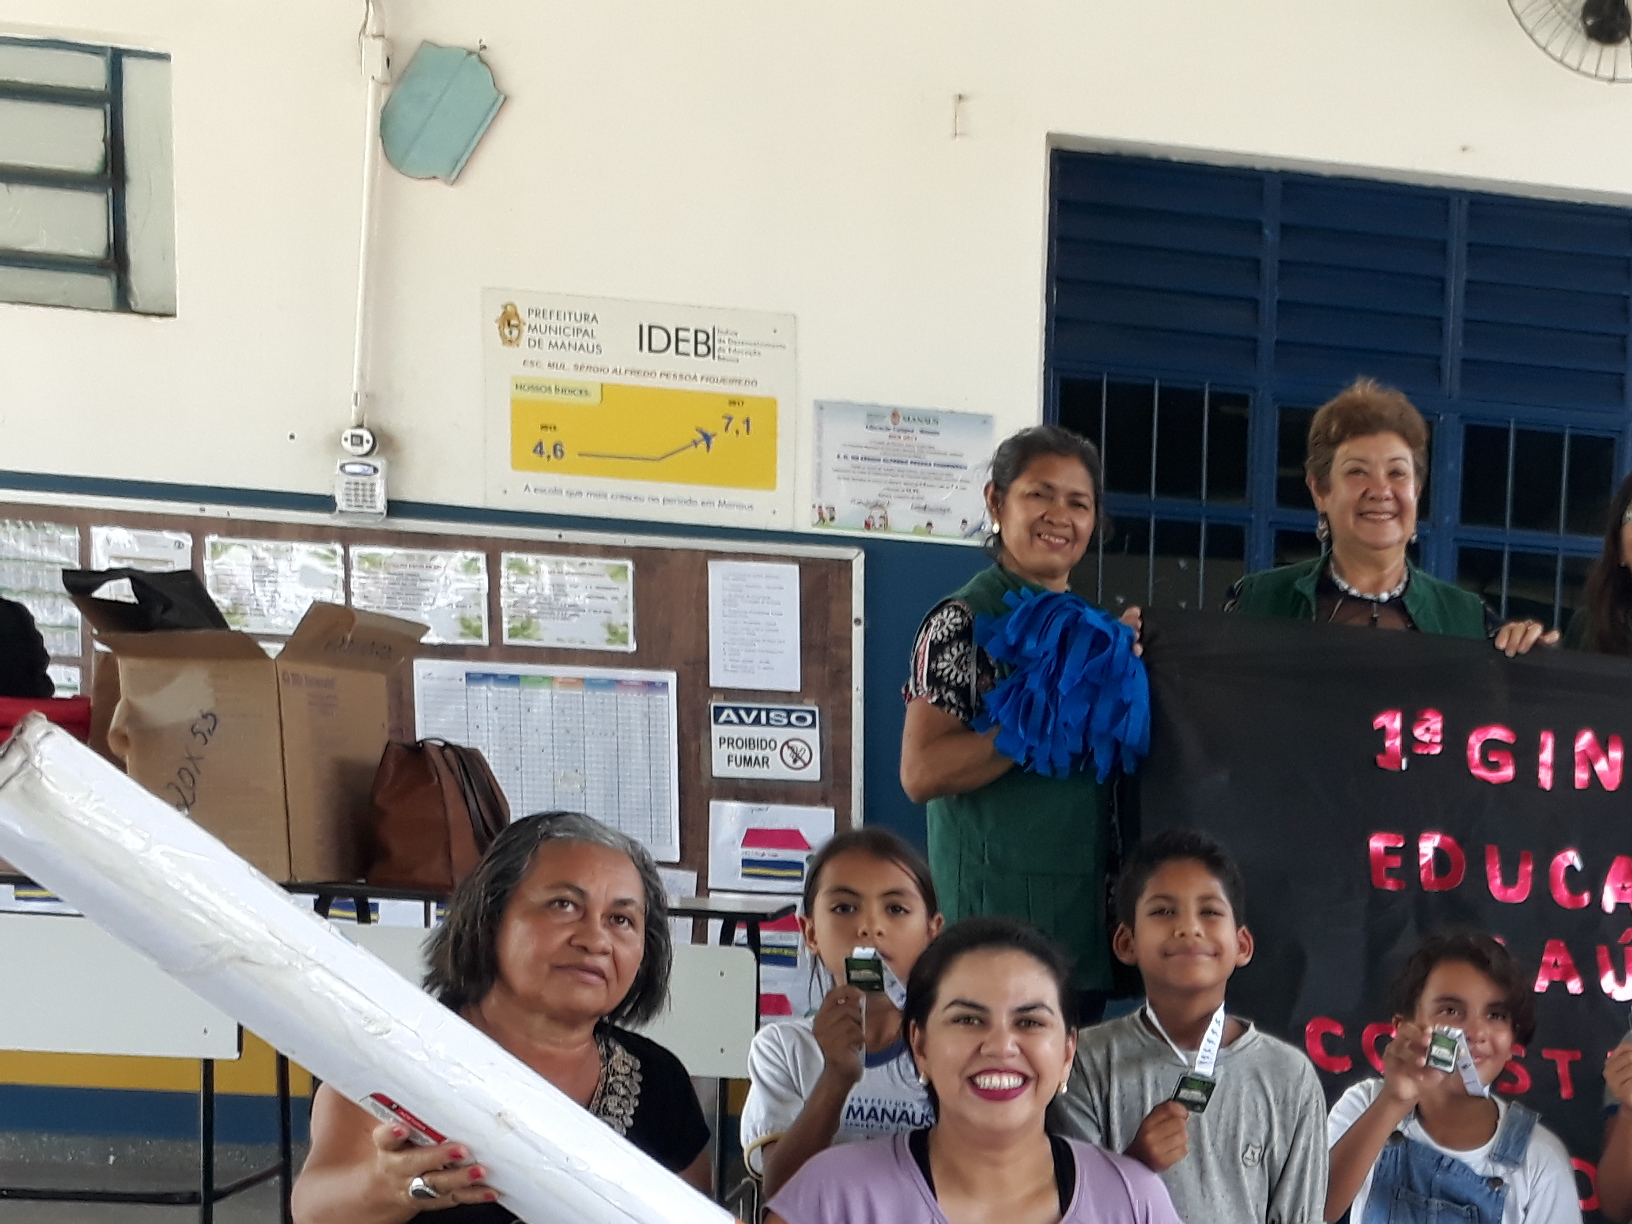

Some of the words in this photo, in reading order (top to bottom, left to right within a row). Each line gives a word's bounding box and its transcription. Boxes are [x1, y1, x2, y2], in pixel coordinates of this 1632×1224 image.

[527, 308, 599, 325] PREFEITURA
[527, 323, 597, 339] MUNICIPAL
[638, 323, 711, 358] IDEB
[527, 337, 543, 350] DE
[548, 339, 602, 355] MANAUS
[722, 414, 752, 437] 7,1
[532, 439, 565, 462] 4,6
[715, 707, 814, 728] AVISO
[718, 735, 778, 752] PROIBIDO
[727, 754, 770, 769] FUMAR
[845, 1104, 932, 1128] MANAUS
